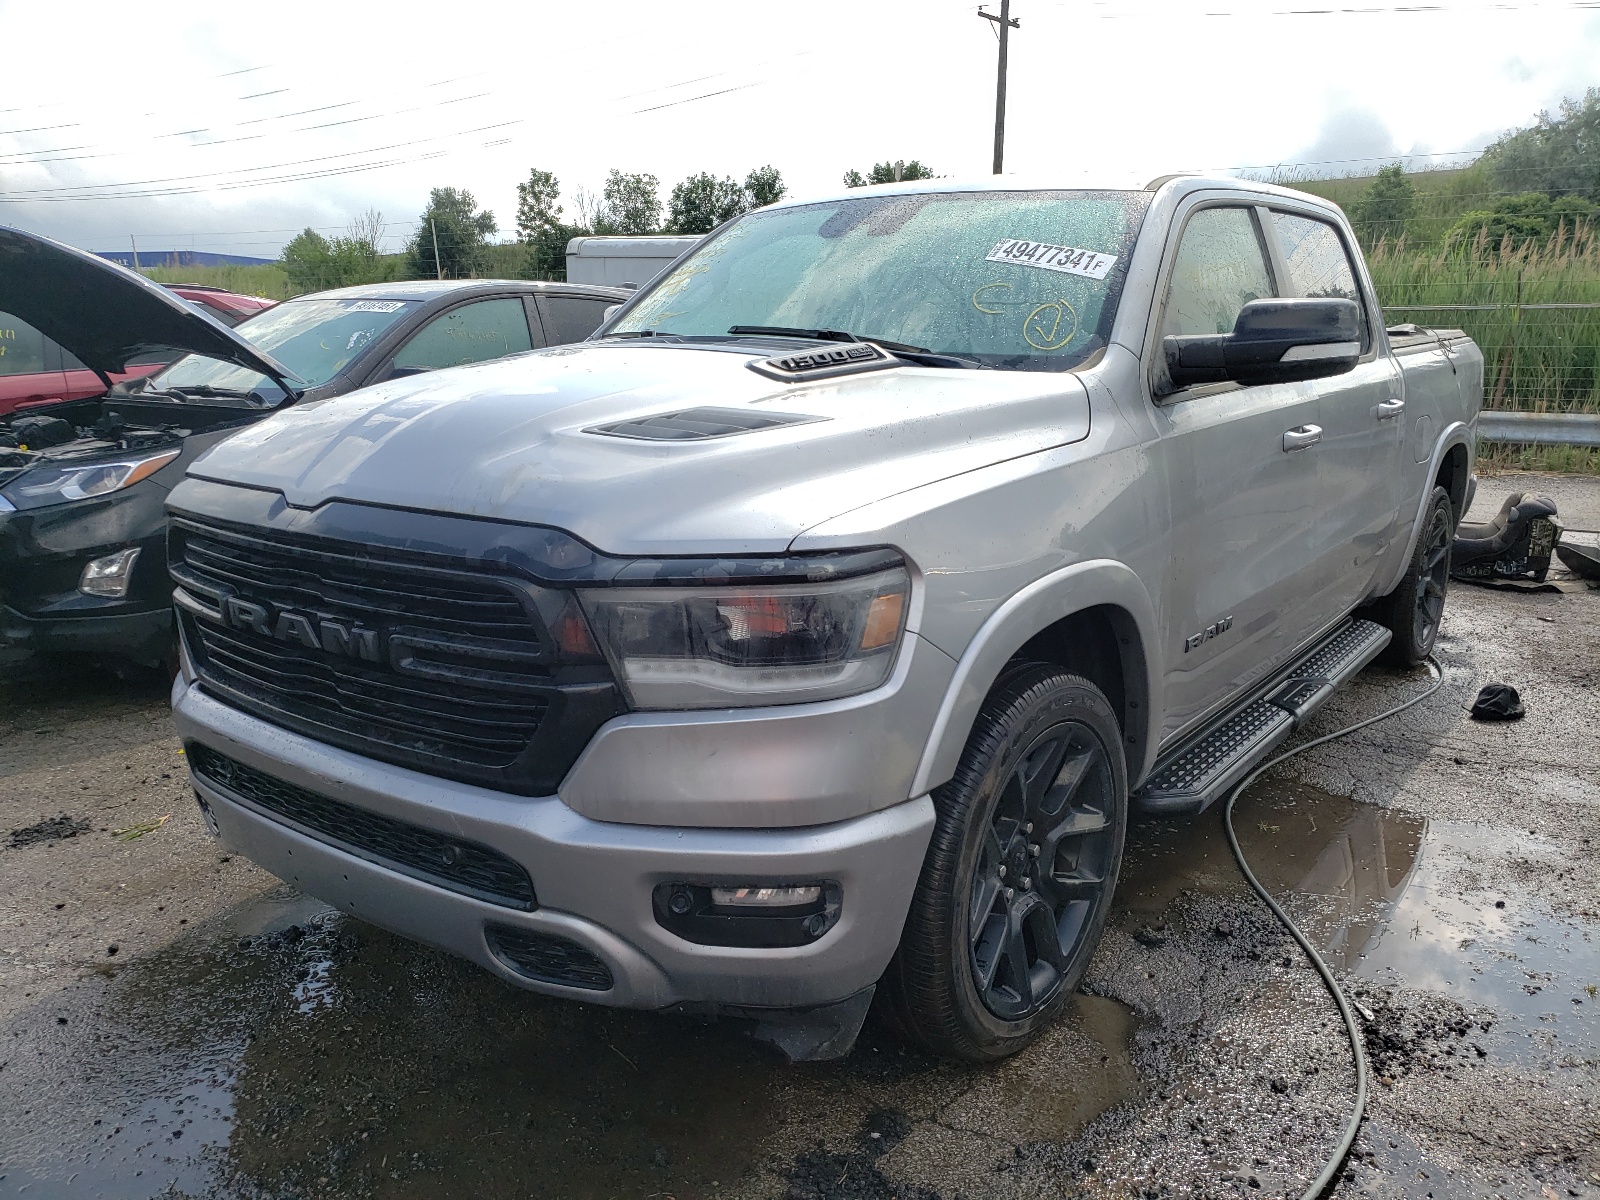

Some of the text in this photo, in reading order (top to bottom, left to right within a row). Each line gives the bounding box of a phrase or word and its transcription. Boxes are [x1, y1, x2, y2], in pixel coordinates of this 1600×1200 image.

[780, 350, 849, 371] 1500
[227, 594, 382, 664] RAM
[1183, 614, 1233, 654] RAM
